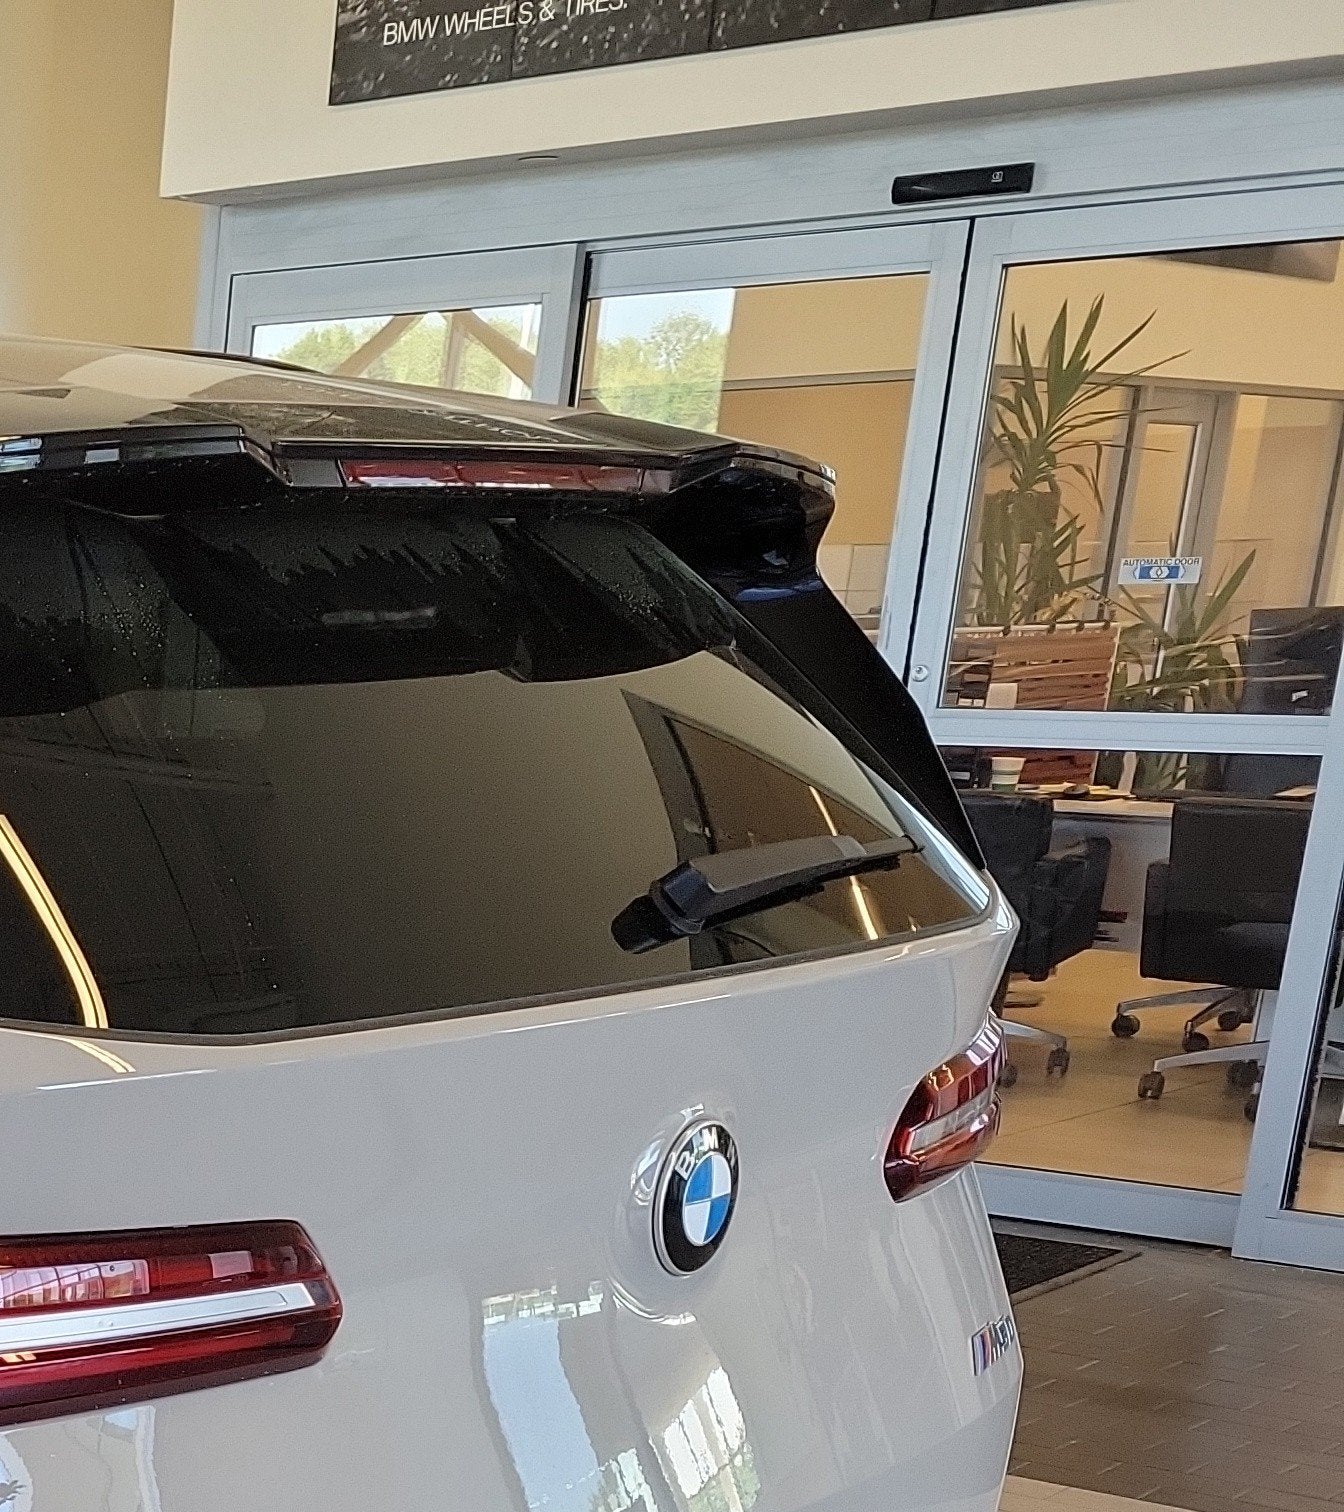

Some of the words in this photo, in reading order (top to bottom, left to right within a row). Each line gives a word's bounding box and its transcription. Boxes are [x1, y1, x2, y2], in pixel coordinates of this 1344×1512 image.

[383, 14, 440, 46] BMW
[444, 1, 534, 36] WHEELS
[539, 0, 556, 22] &
[1123, 558, 1173, 567] AUTOMATIC
[1174, 557, 1200, 566] DOOR
